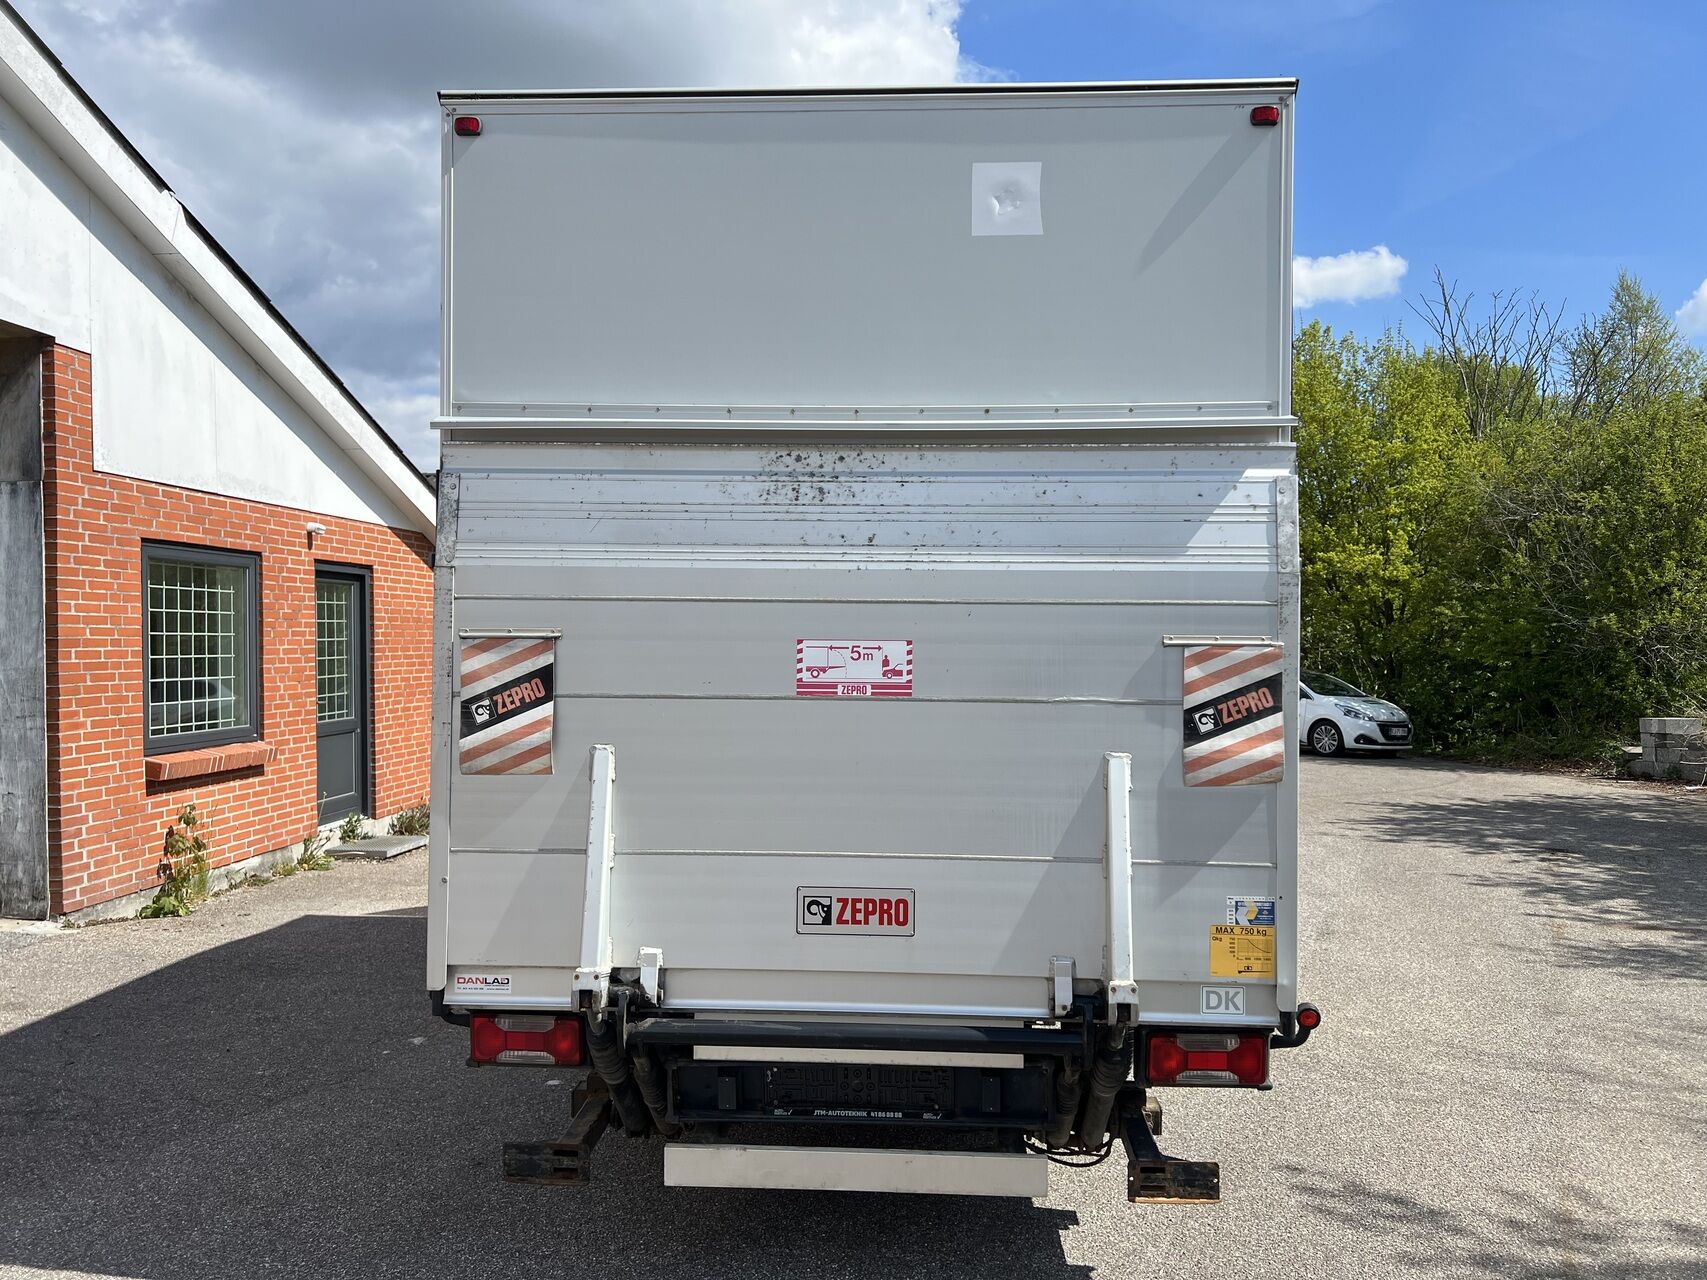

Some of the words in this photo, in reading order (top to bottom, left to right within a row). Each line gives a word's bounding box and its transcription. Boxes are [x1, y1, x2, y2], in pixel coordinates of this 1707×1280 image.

[493, 678, 545, 714] ZEPRO
[841, 685, 867, 695] ZEPRO
[1218, 687, 1274, 724] ZEPRO
[836, 897, 909, 927] ZEPRO
[1215, 926, 1235, 934] MAX
[1240, 927, 1254, 935] 750
[1256, 928, 1267, 937] kg
[457, 976, 510, 985] DANLAD
[1205, 990, 1241, 1011] DK
[813, 1109, 867, 1117] JTM-AUTOTEKNIK
